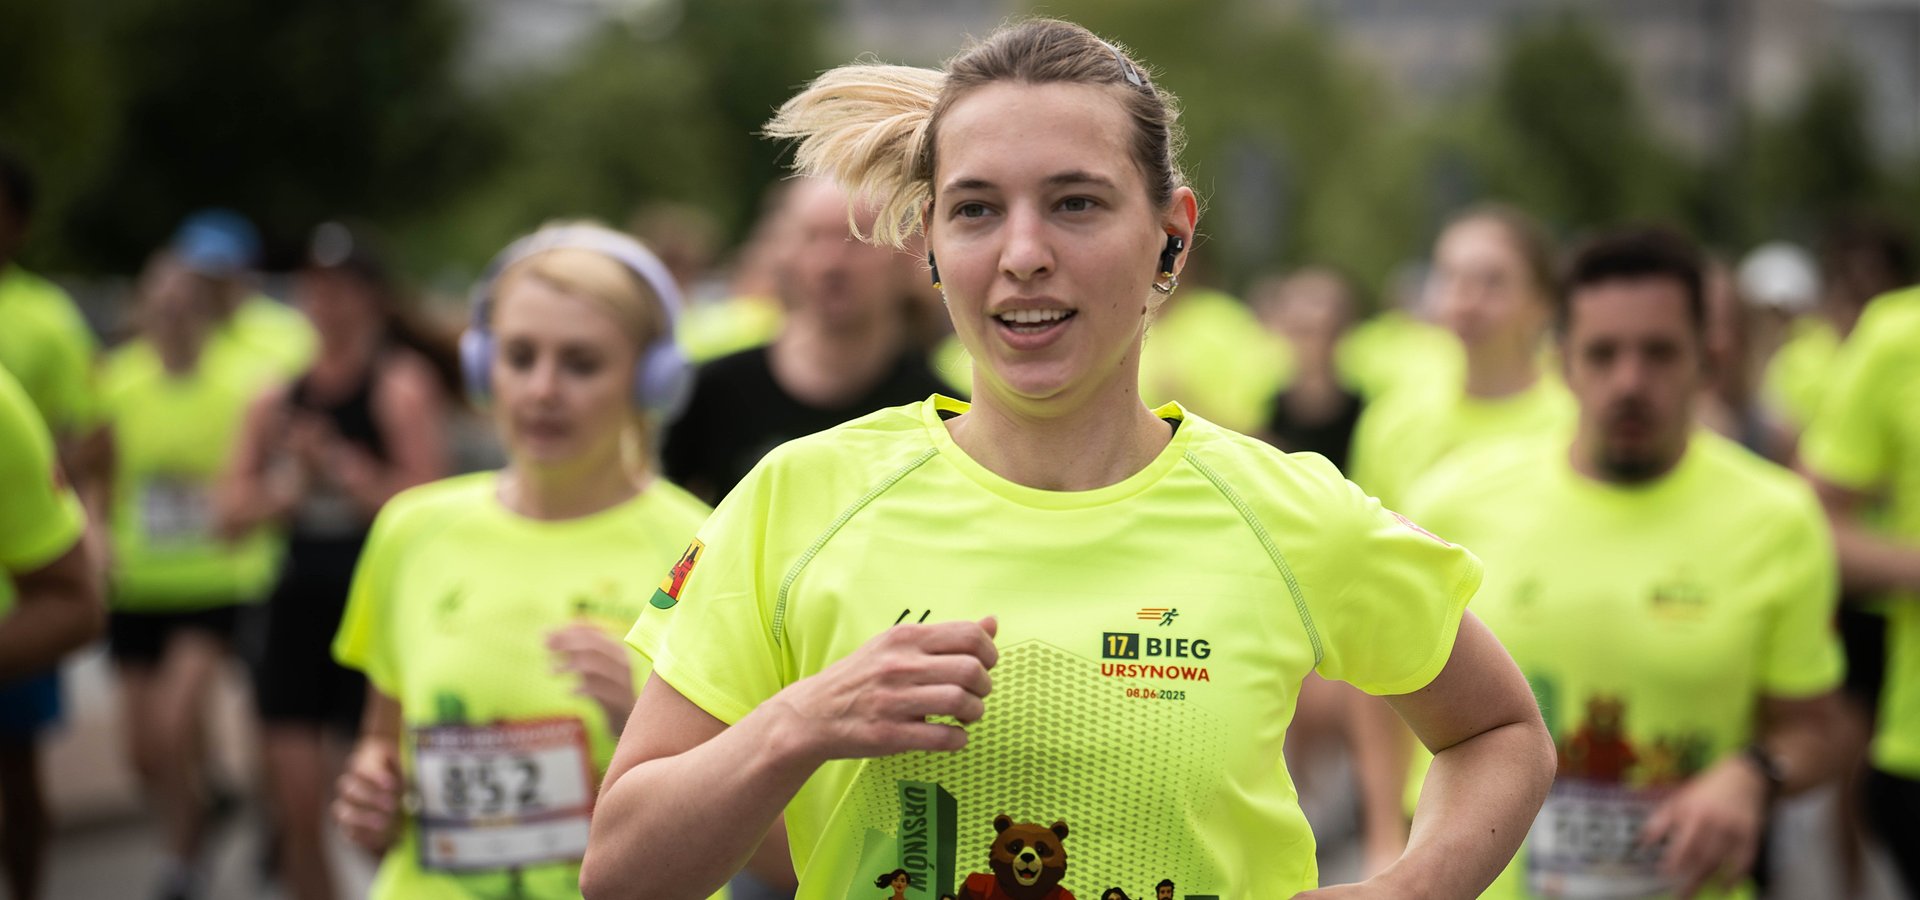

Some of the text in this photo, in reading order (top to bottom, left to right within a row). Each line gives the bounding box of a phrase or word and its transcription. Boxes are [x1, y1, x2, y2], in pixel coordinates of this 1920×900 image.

[1107, 635, 1211, 659] 17. BIEG
[1101, 663, 1210, 682] URSYNOWA
[1126, 688, 1186, 700] 08.06.2025
[443, 757, 541, 814] 852
[903, 786, 935, 893] URSYNÓW
